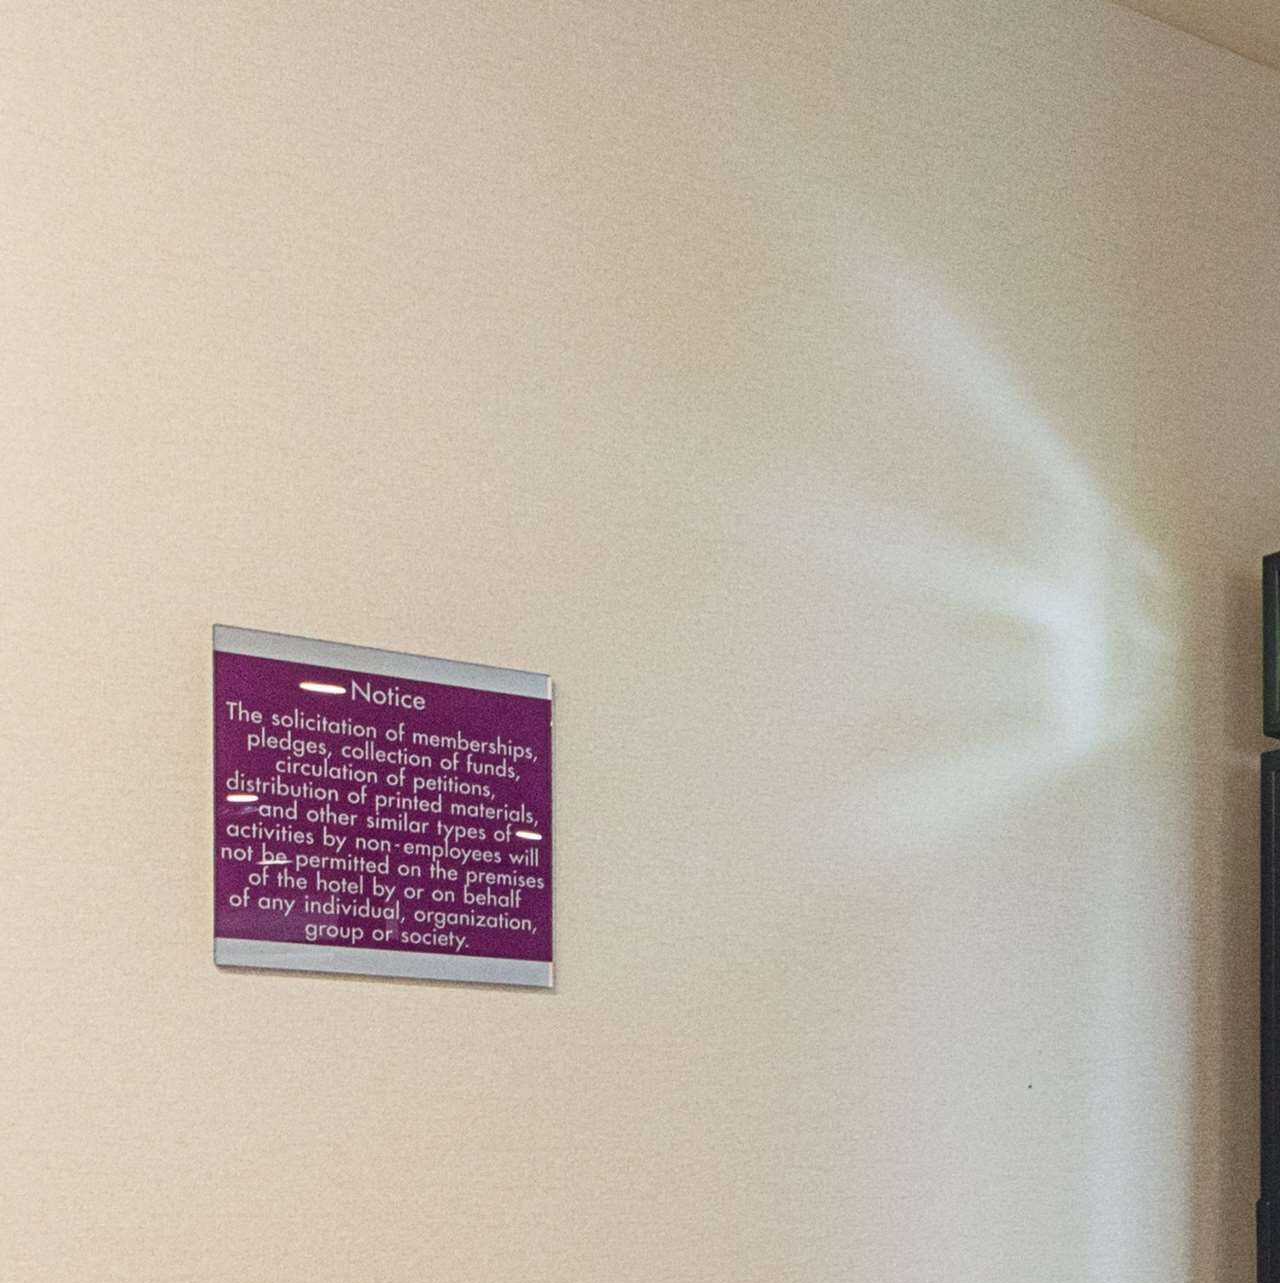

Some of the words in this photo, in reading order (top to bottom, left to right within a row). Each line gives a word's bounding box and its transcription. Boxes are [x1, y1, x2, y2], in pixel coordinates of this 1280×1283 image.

[351, 681, 425, 710] Notice
[226, 702, 262, 724] The
[272, 708, 376, 738] solicitation
[386, 723, 404, 741] of
[412, 731, 538, 761] memberships,
[248, 732, 331, 758] pledges,
[342, 744, 431, 768] collection
[440, 754, 459, 771] of
[467, 755, 520, 782] funds,
[276, 758, 377, 783] circulation
[386, 774, 405, 790] of
[413, 777, 495, 800] petitions,
[227, 771, 338, 801] distribution
[348, 787, 366, 803] of
[376, 791, 441, 813] printed
[450, 801, 538, 827] materials,
[227, 822, 314, 844] activities
[323, 832, 346, 852] by
[509, 849, 539, 866] will
[259, 801, 297, 819] and
[307, 803, 357, 827] other
[367, 815, 428, 834] similar
[438, 822, 485, 845] types
[494, 825, 511, 842] of
[221, 846, 253, 861] not
[262, 843, 287, 864] be
[296, 851, 389, 874] permitted
[398, 864, 421, 878] on
[430, 863, 457, 881] the
[466, 871, 544, 895] premises
[249, 871, 268, 886] of
[277, 871, 307, 889] the
[317, 876, 363, 893] hotel
[373, 878, 395, 901] by
[404, 884, 424, 899] or
[432, 889, 454, 902] on
[464, 886, 521, 909] behalf
[230, 890, 249, 907] of
[258, 896, 294, 916] any
[305, 898, 405, 923] individual,
[414, 907, 536, 933] organization,
[305, 924, 364, 944] group
[372, 925, 393, 941] or
[401, 929, 468, 951] society.
